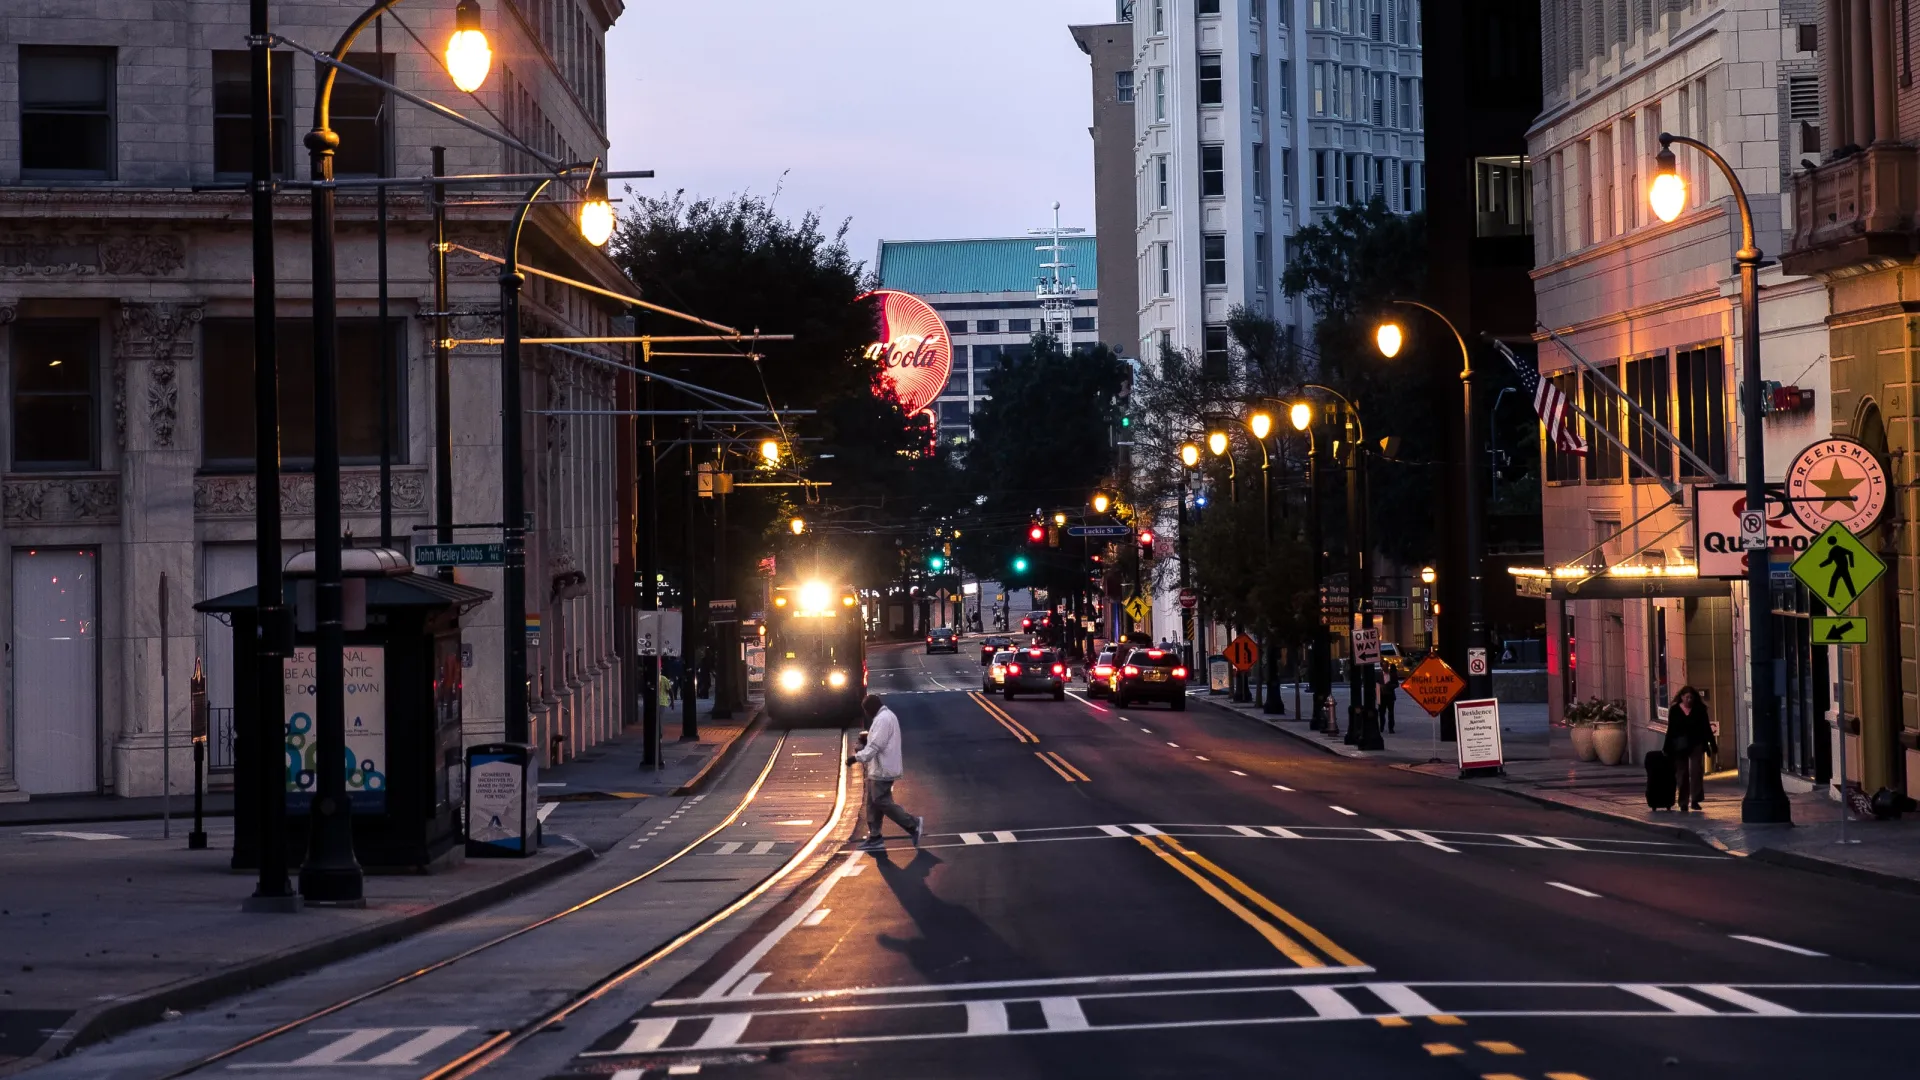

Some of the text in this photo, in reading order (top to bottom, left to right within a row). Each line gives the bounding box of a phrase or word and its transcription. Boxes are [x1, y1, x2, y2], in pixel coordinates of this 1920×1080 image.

[1793, 444, 1882, 487] BREENSMITH
[1799, 503, 1878, 530] ADVEISING
[416, 544, 501, 564] John Wesley Dobbs AVE
[1642, 582, 1664, 594] 134
[1355, 631, 1376, 641] ONE
[1356, 641, 1377, 651] WAY
[291, 652, 304, 663] BE
[284, 667, 373, 679] BE AUNTIC
[1411, 675, 1455, 684] RIGHT LANE
[1419, 686, 1448, 695] CLOSED
[1423, 696, 1447, 705] AHEAD
